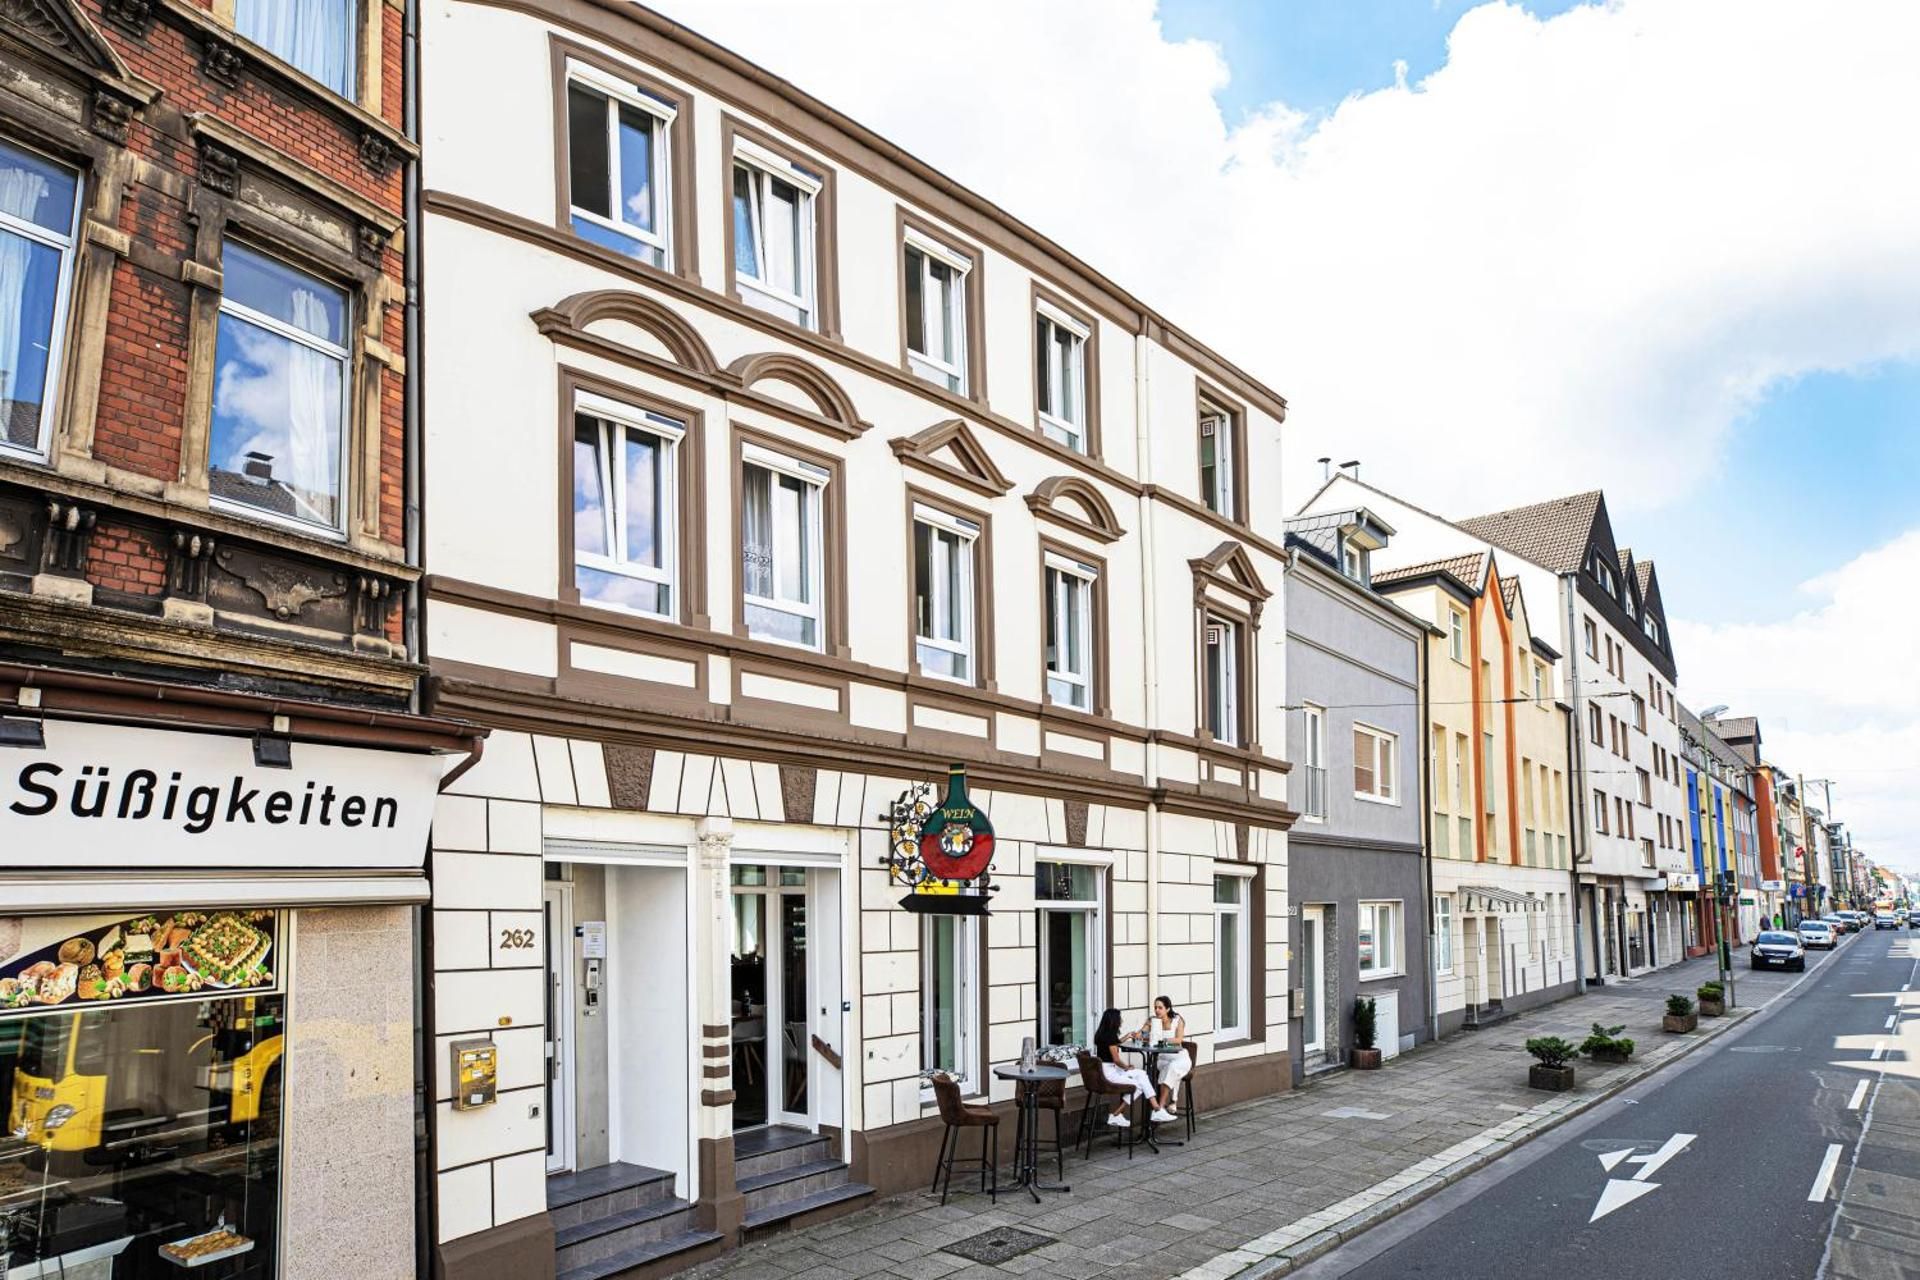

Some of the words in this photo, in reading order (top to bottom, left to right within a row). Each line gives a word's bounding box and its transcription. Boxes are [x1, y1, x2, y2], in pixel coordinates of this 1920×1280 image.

[9, 762, 398, 834] Süßigkeiten
[940, 808, 976, 819] WEIN
[500, 929, 535, 949] 262
